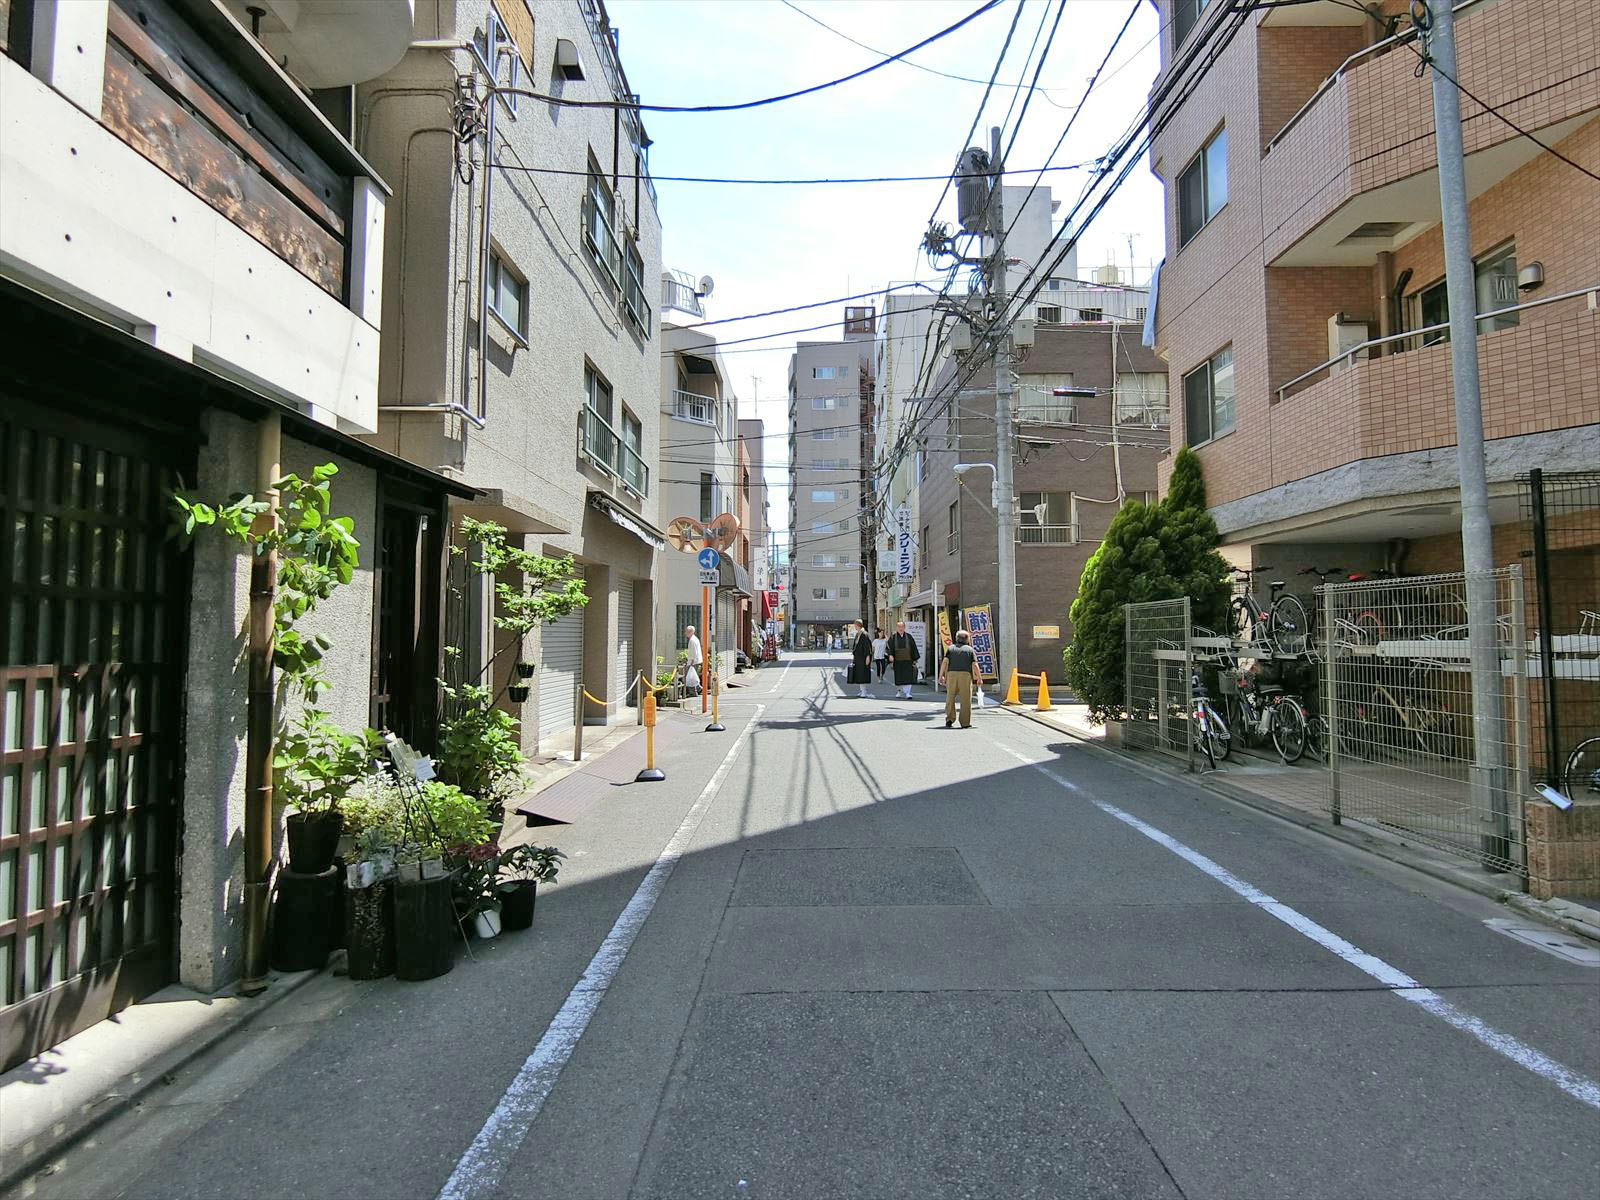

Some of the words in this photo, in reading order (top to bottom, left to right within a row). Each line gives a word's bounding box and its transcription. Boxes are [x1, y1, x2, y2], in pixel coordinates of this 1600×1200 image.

[899, 532, 911, 574] クリーニング
